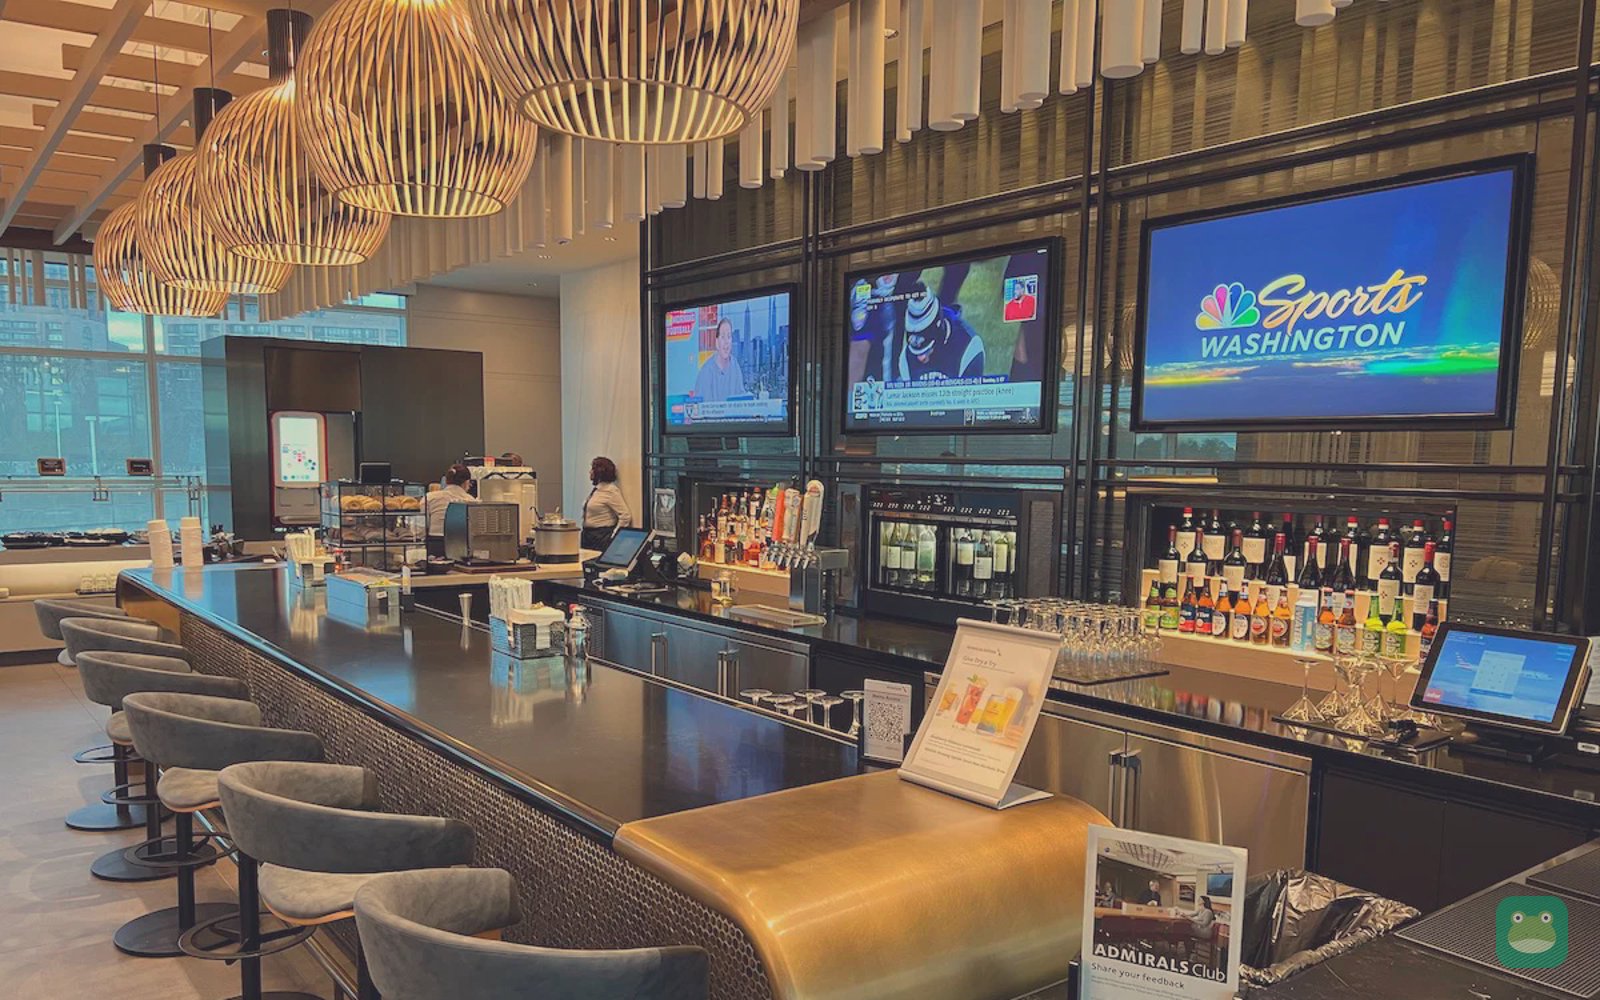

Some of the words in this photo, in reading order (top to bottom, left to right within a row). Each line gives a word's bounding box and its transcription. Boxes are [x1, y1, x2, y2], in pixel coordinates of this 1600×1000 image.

[1258, 268, 1428, 336] Sports
[1201, 320, 1406, 358] WASHINGTON
[1091, 962, 1117, 974] Share
[1119, 970, 1140, 979] your
[1142, 973, 1185, 990] feedback
[1094, 943, 1189, 974] ADMIRALS
[1192, 963, 1226, 981] Club
